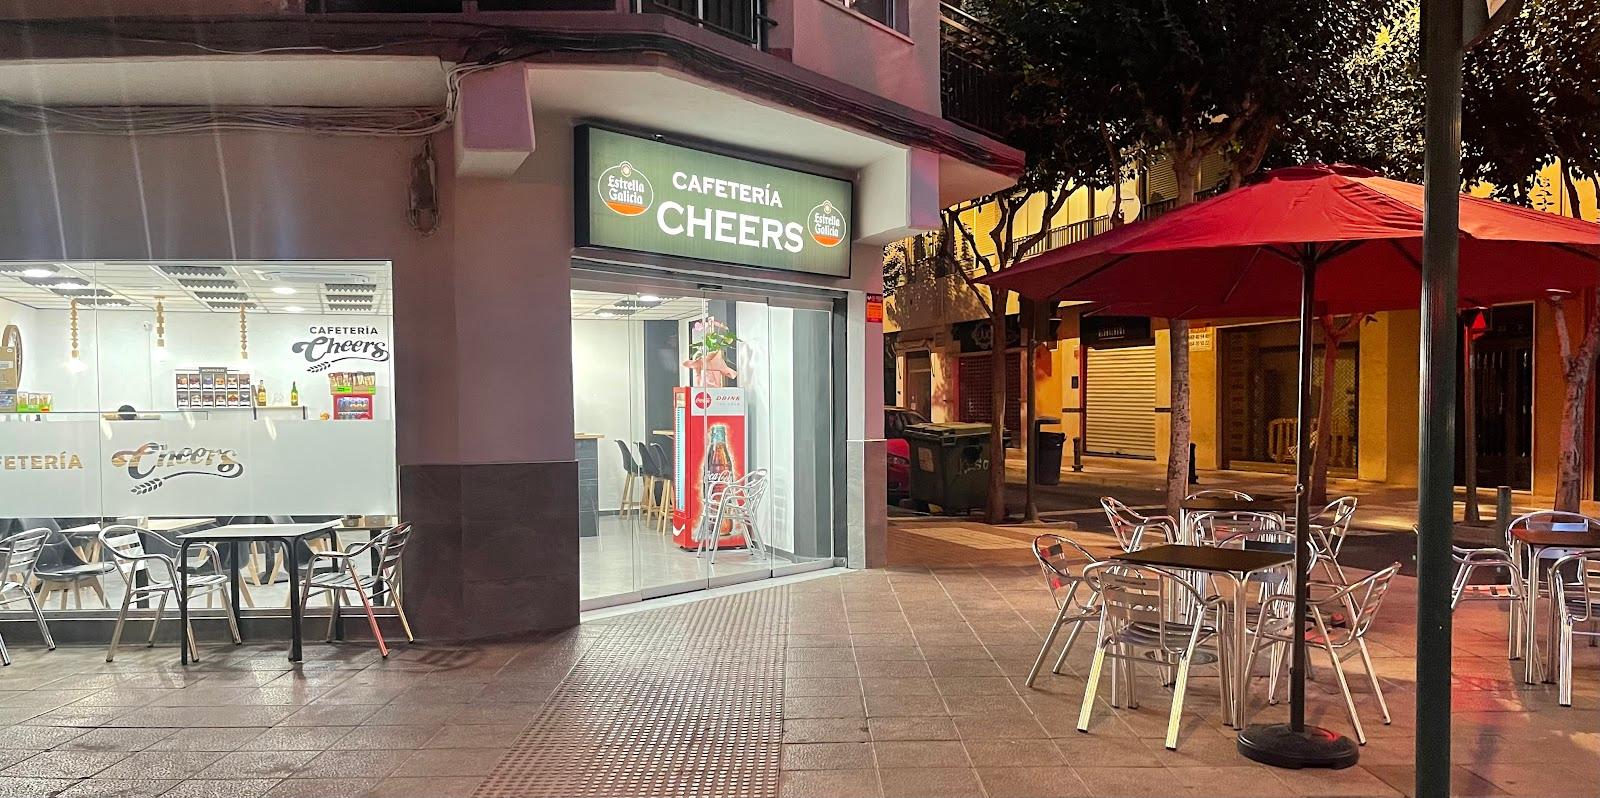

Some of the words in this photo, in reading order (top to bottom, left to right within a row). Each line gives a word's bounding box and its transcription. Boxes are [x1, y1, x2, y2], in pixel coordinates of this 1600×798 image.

[608, 175, 645, 192] Estrella
[672, 171, 783, 208] CAFETERÍA
[608, 188, 643, 205] Galicia
[657, 201, 804, 253] CHEERS
[814, 212, 841, 227] Estrella
[814, 222, 840, 237] Galicia
[309, 325, 379, 335] CAFETERÍA
[291, 336, 390, 363] Cheers
[0, 451, 84, 470] ETERÍA
[111, 442, 244, 479] Cheers
